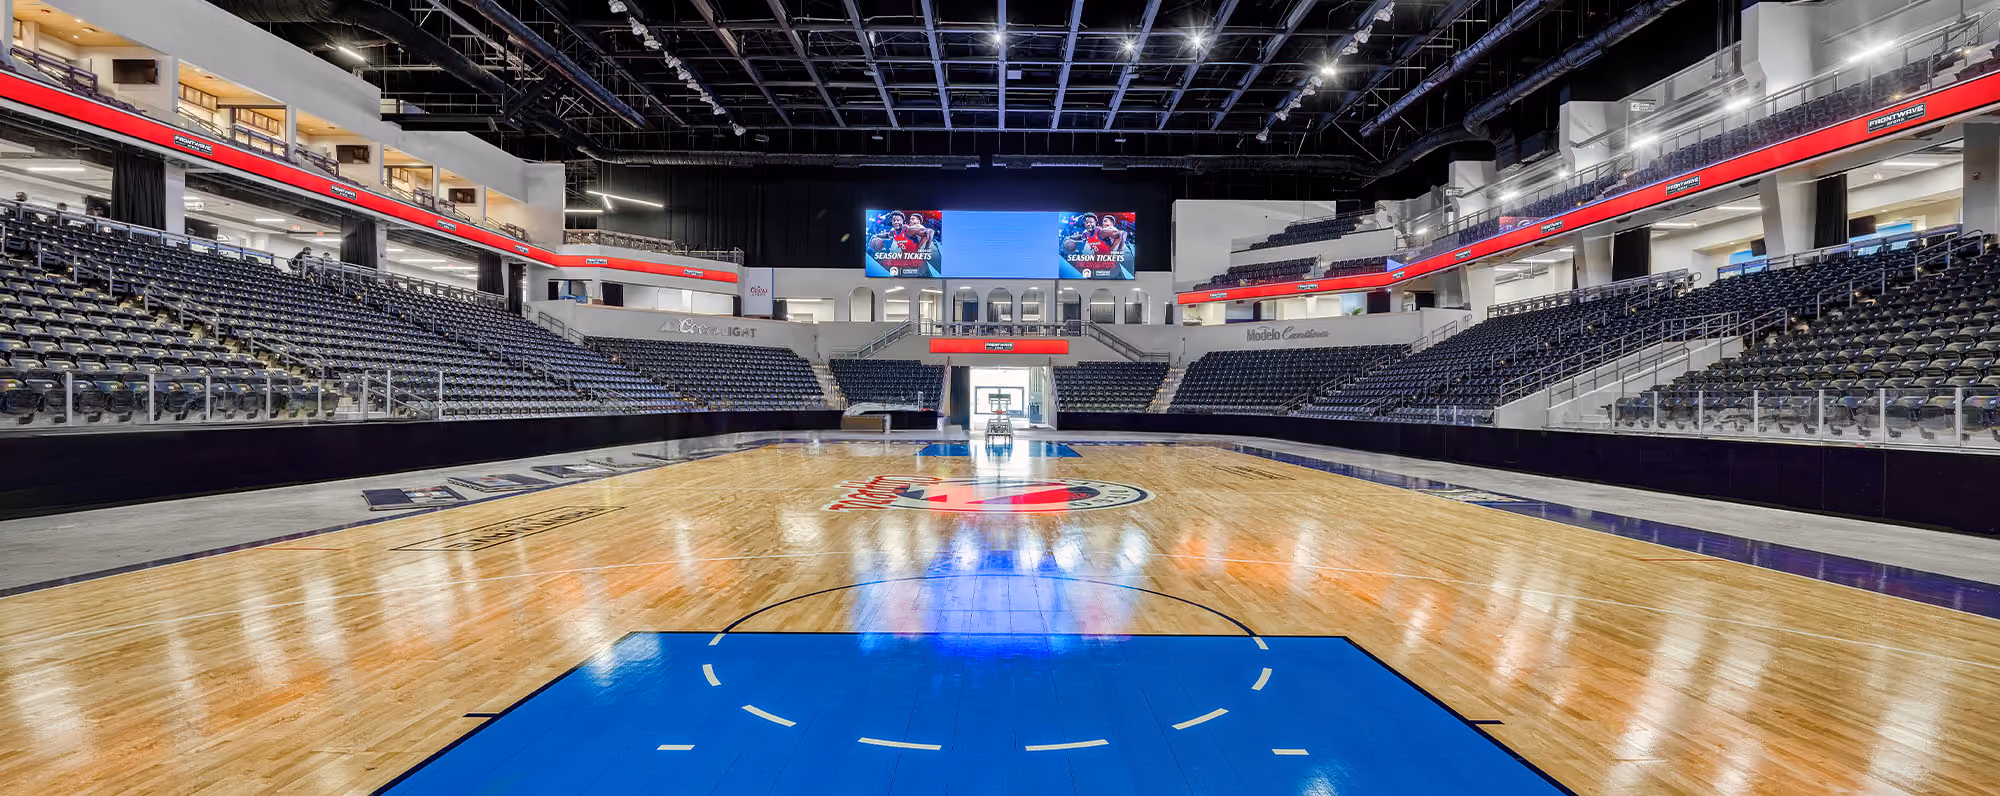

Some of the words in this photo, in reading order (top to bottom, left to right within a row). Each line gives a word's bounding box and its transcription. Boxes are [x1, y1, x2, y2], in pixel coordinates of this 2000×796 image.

[1870, 104, 1924, 126] FRONTWAVE
[1886, 118, 1905, 126] arena
[721, 326, 757, 338] LIGHT
[1247, 328, 1280, 342] Modelo
